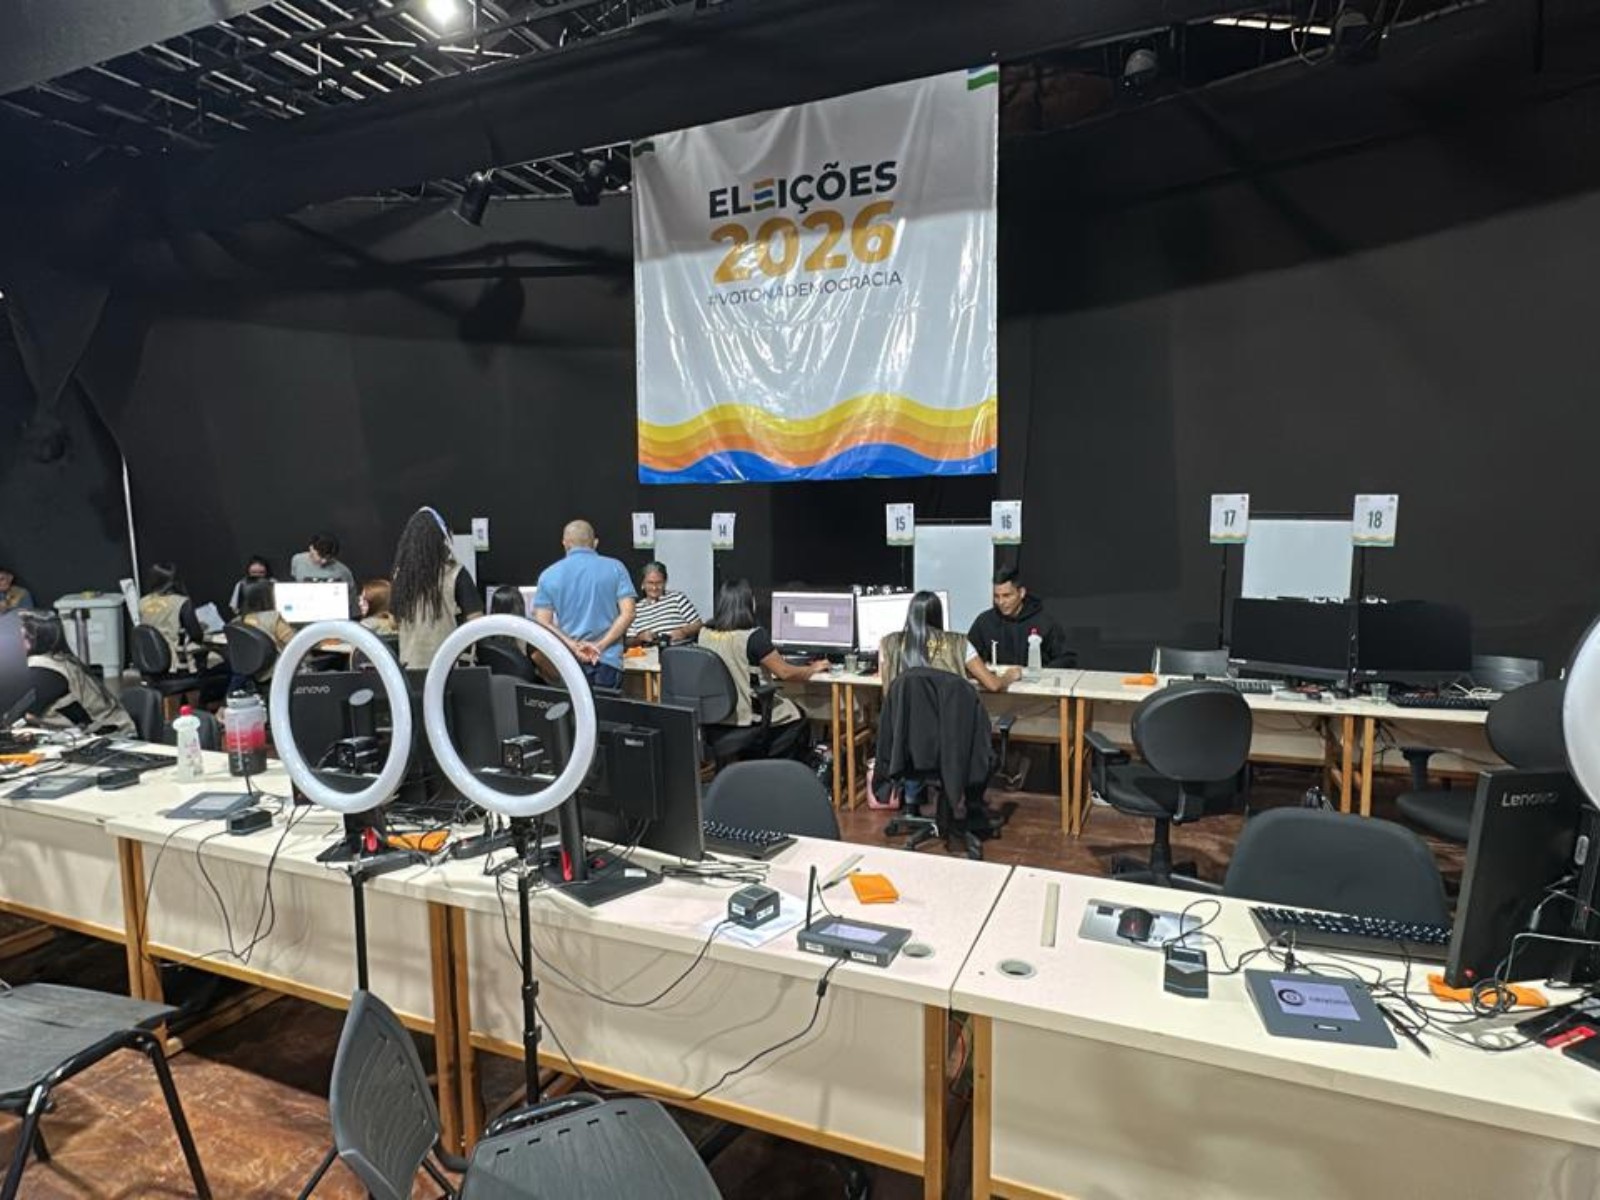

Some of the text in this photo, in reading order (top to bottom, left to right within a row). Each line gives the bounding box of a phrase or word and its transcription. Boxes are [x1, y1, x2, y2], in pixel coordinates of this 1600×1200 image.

[709, 160, 898, 219] ELEIÇÕES
[711, 200, 897, 284] 2026
[708, 271, 902, 307] #VOTONADEMOCRACIA
[895, 516, 906, 532] 15
[1001, 514, 1013, 530] 16
[1223, 509, 1236, 527] 17
[1367, 510, 1383, 529] 18
[1502, 791, 1559, 807] Lenovo
